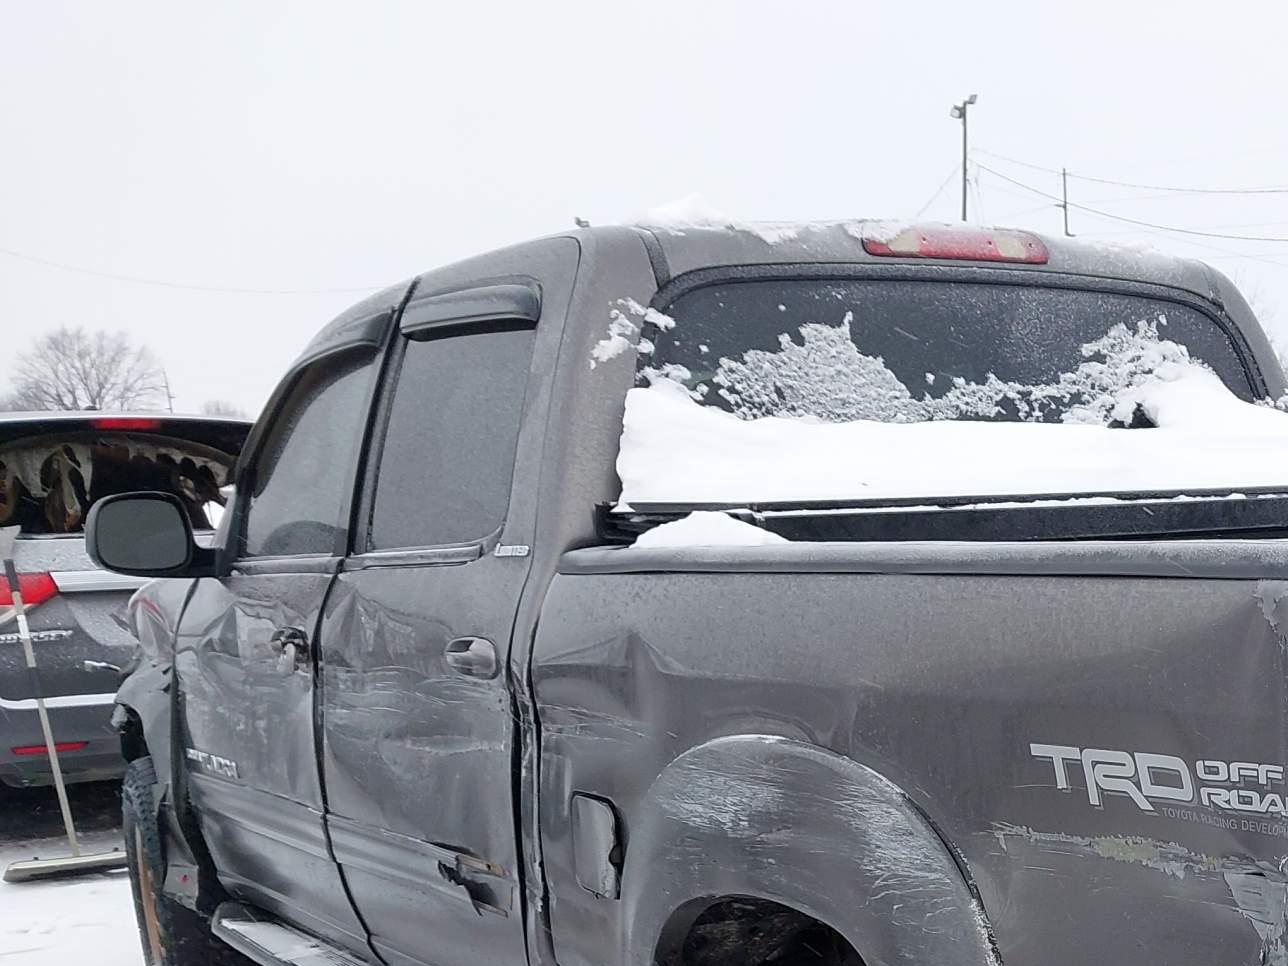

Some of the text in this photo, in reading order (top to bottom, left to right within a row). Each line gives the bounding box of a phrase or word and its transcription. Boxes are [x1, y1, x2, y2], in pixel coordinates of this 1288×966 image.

[1030, 743, 1284, 811] TRD OFF
[1162, 806, 1200, 822] TOYOTA
